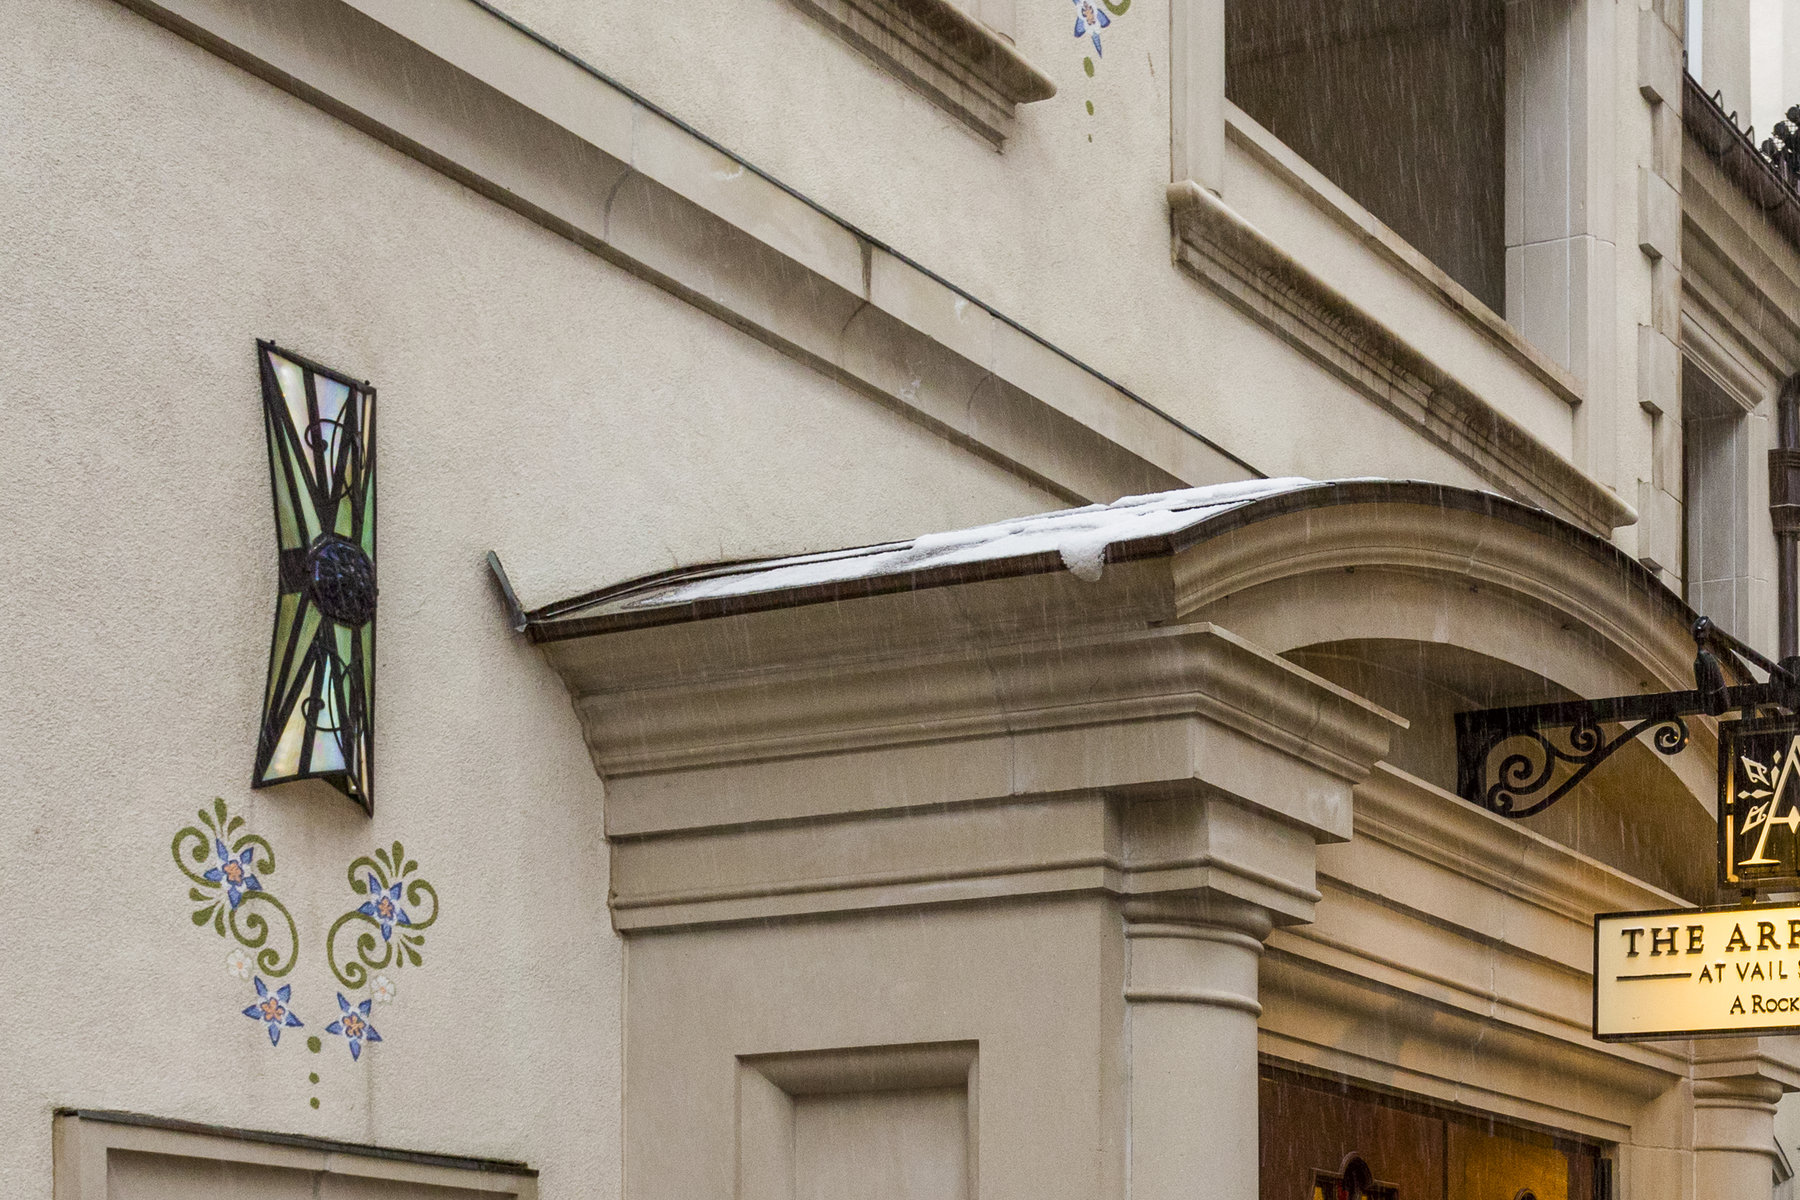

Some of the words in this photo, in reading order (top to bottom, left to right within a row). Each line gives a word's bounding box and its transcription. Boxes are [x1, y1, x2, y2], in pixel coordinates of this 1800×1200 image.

[1621, 924, 1705, 958] THE
[1698, 963, 1727, 984] AT
[1735, 960, 1788, 982] VAIL
[1729, 994, 1746, 1016] A
